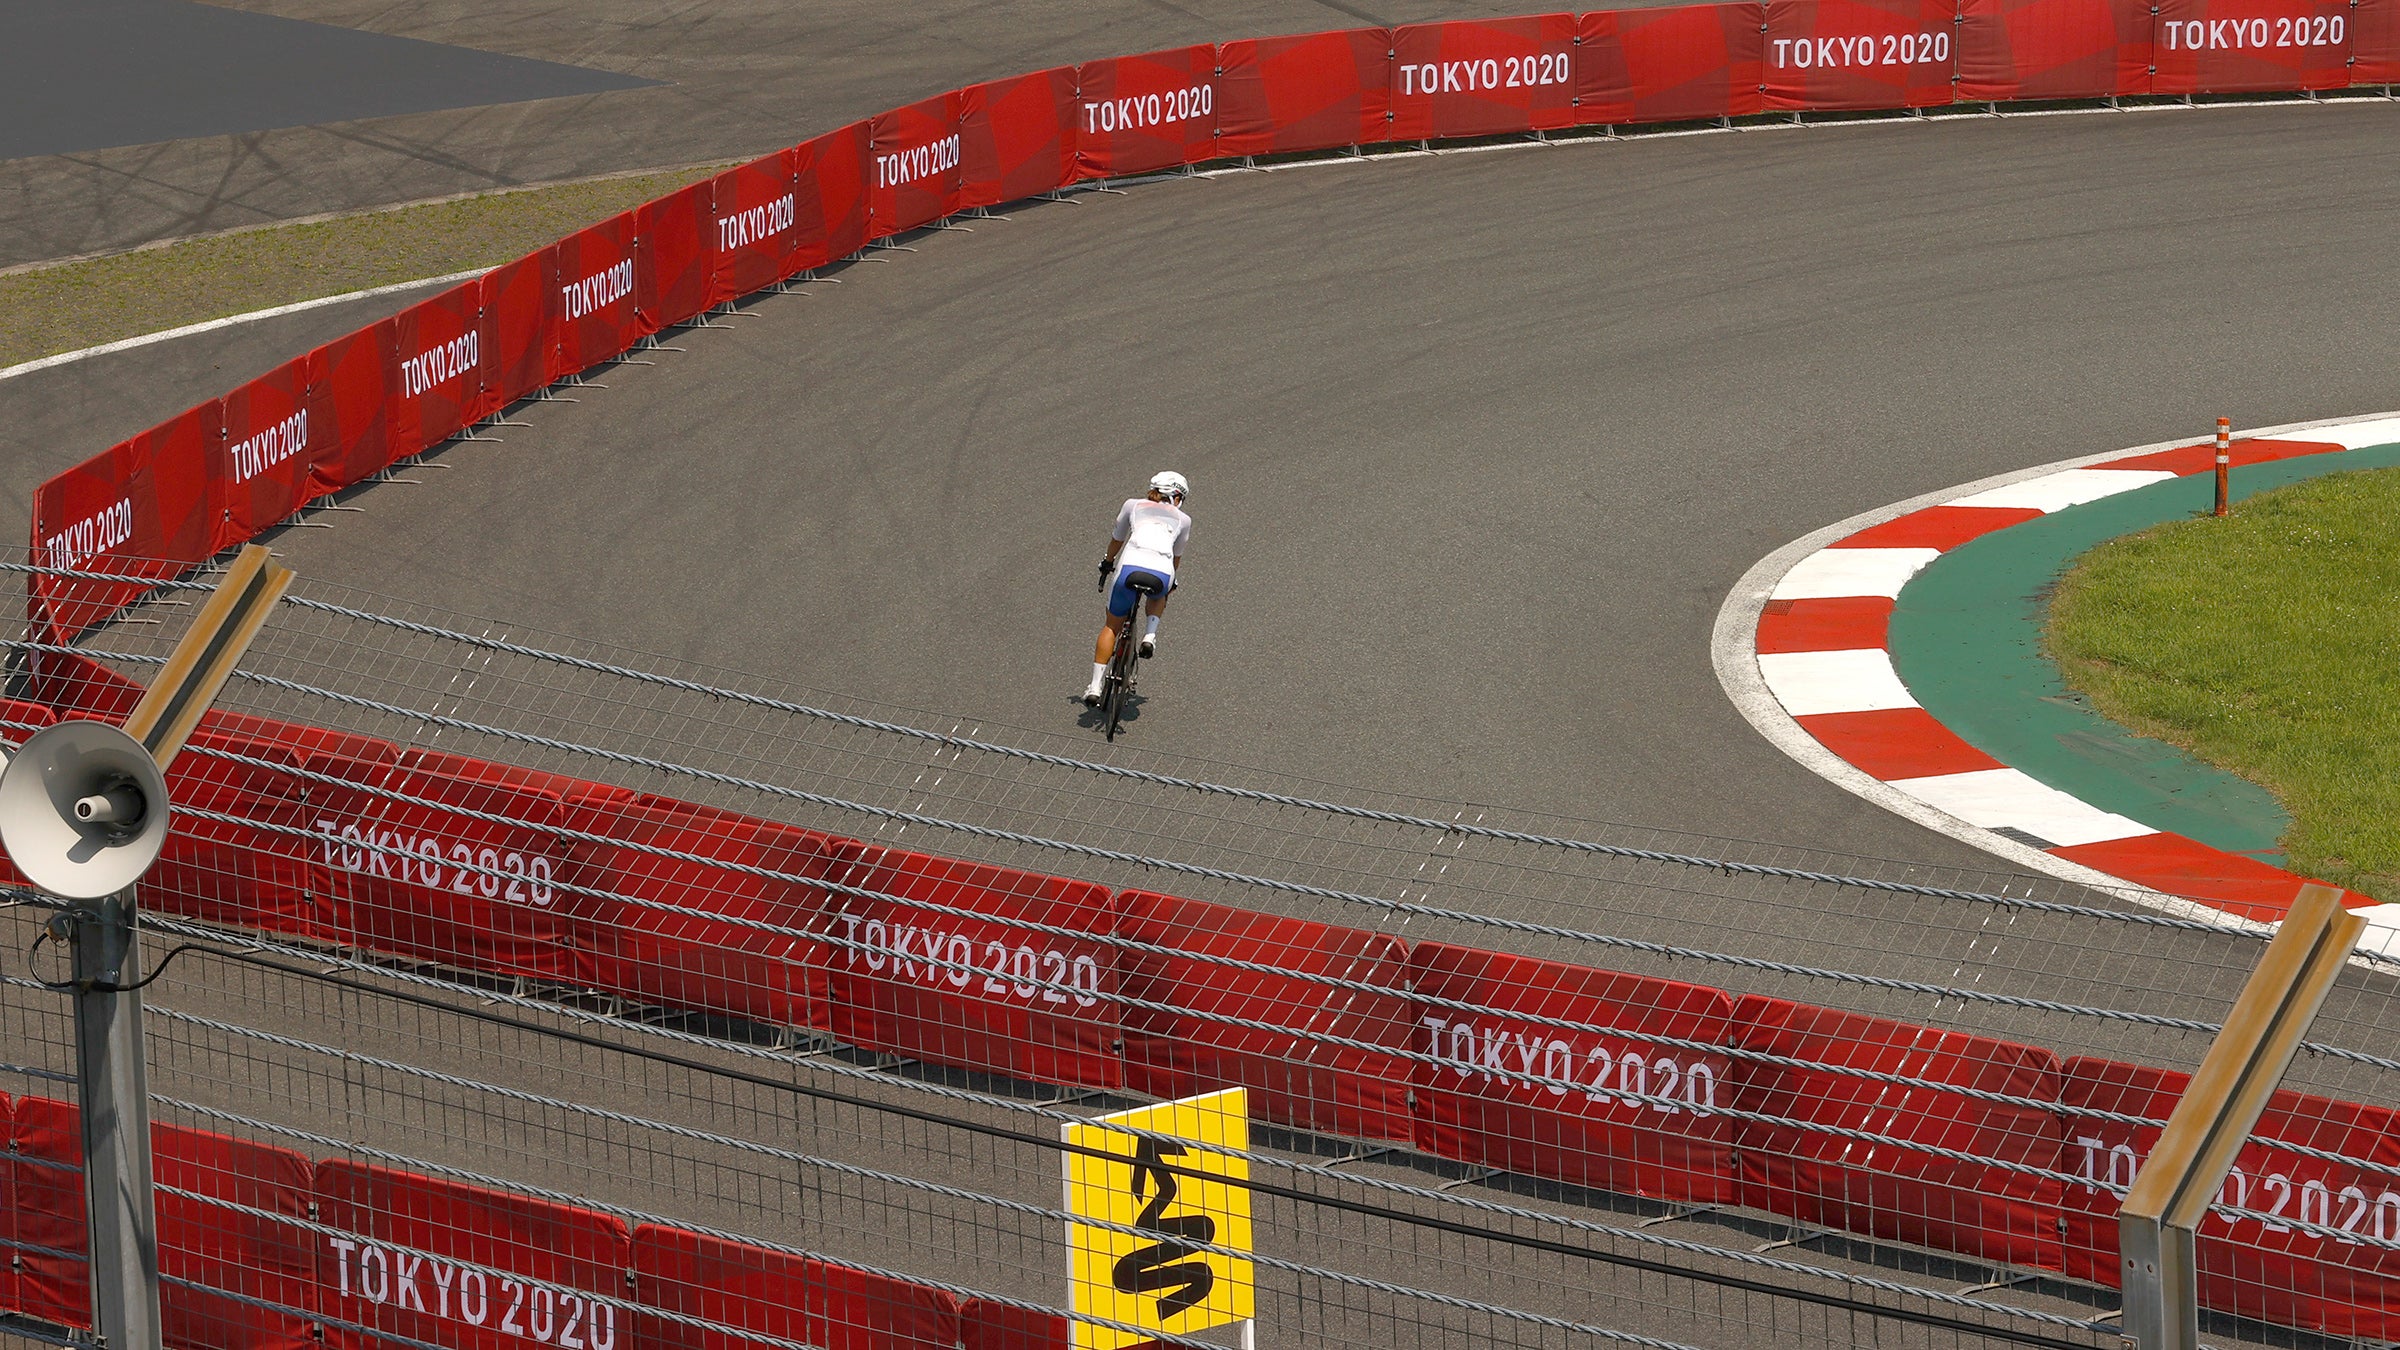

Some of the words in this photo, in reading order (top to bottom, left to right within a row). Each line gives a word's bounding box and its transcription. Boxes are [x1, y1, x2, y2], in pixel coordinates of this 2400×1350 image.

[1774, 37, 1875, 69] TOKYO
[1882, 33, 1949, 65] 2020
[2165, 19, 2268, 50] TOKYO
[2276, 16, 2344, 46] 2020
[1401, 59, 1498, 96] TOKYO
[1505, 53, 1569, 88] 2020
[1085, 94, 1160, 134] TOKYO
[1165, 85, 1212, 123] 2020
[877, 146, 928, 189] TOKYO
[931, 134, 960, 175] 2020
[719, 206, 765, 253] TOKYO
[767, 193, 794, 236] 2020
[563, 272, 606, 322] TOKYO
[607, 258, 632, 304] 2020
[402, 346, 445, 399] TOKYO
[447, 330, 478, 379] 2020
[231, 427, 277, 484] TOKYO
[279, 408, 307, 461] 2020
[46, 517, 93, 580] TOKYO
[97, 498, 131, 554] 2020
[317, 820, 441, 888] TOKYO
[453, 844, 550, 905] 2020
[842, 914, 971, 987] TOKYO
[984, 940, 1097, 1007] 2020
[1424, 1016, 1572, 1096] TOKYO
[1586, 1047, 1714, 1118] 2020
[2077, 1136, 2246, 1224] TOO
[2263, 1174, 2400, 1250] 2020
[330, 1237, 487, 1325] TOKYO
[501, 1279, 614, 1350] 2020
